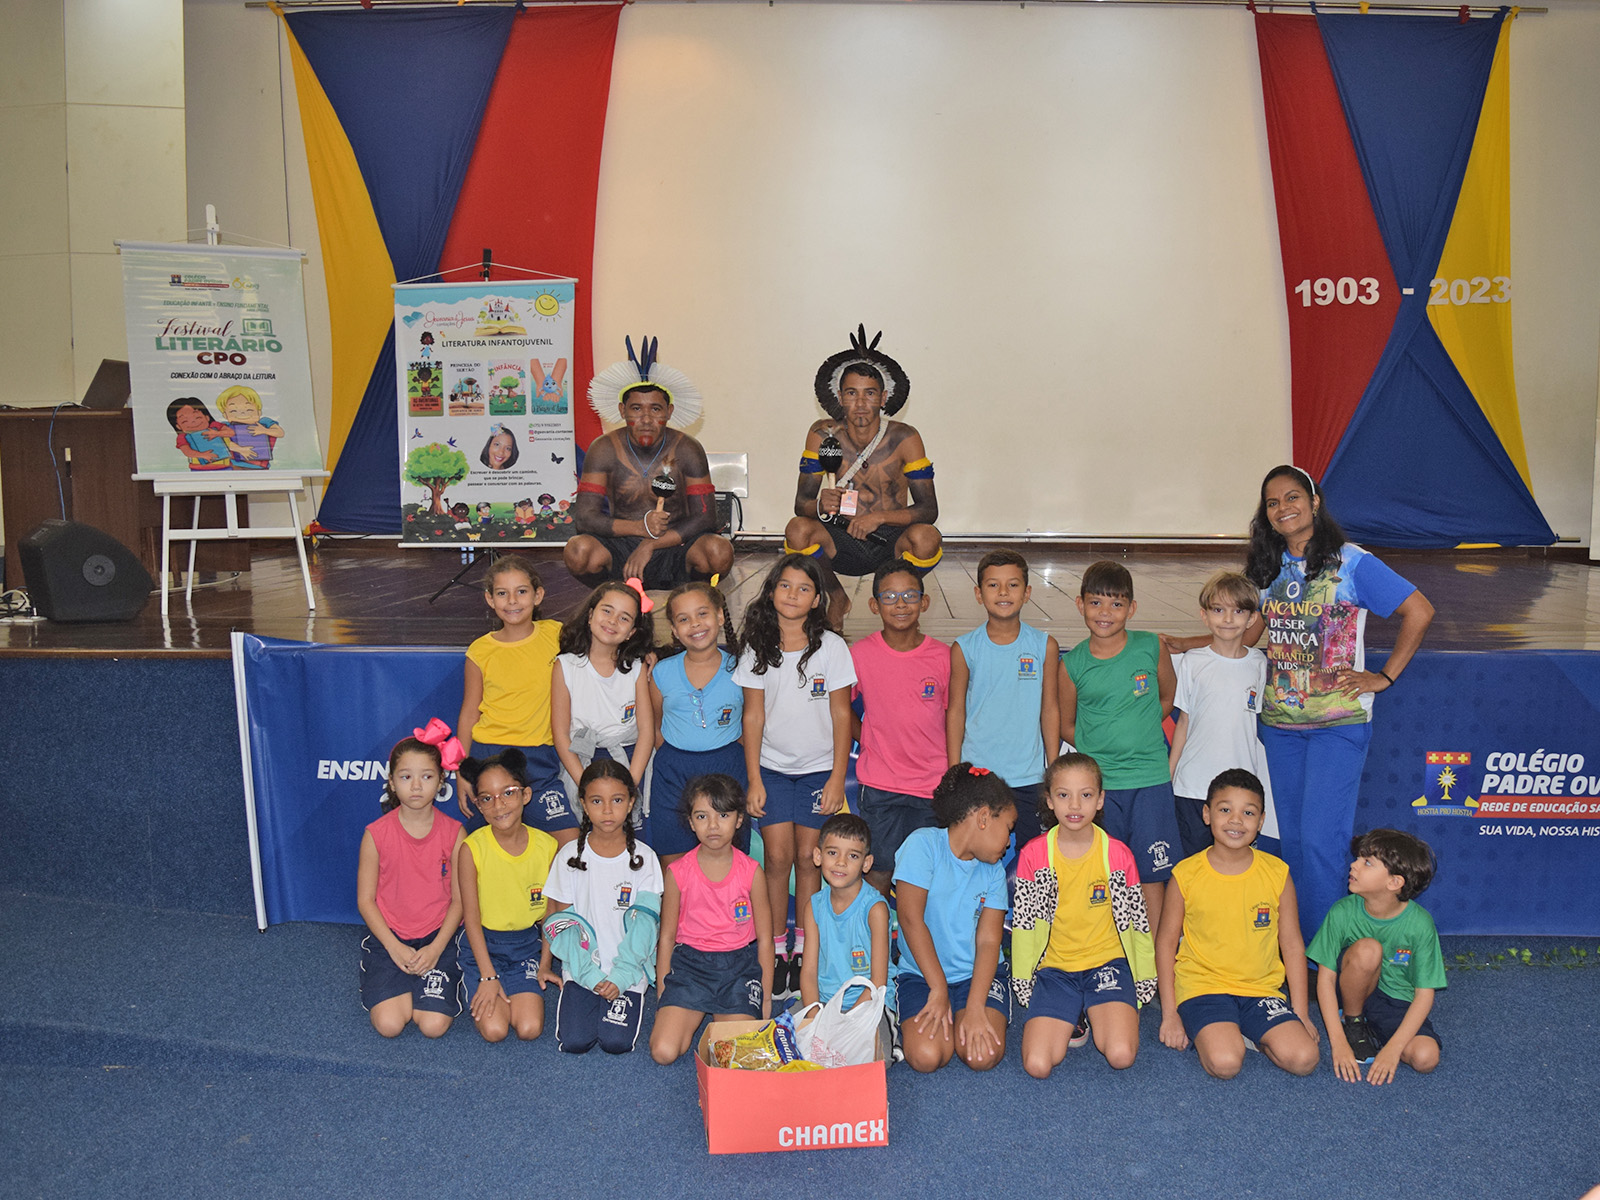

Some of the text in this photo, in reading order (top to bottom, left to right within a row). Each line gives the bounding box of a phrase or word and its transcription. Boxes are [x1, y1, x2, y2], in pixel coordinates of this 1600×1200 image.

[1295, 277, 1379, 307] 1903
[1430, 276, 1510, 305] 2023
[157, 318, 234, 337] Festival
[156, 335, 282, 352] LITERÁRIO
[488, 339, 552, 347] INFANTOJUVENIL
[197, 352, 246, 365] CPO
[494, 363, 521, 372] INFÂNCIA
[220, 372, 242, 380] ABRAÇO
[1286, 581, 1300, 599] O
[1262, 597, 1322, 616] ENCANTO
[1278, 661, 1298, 670] KIDS
[1486, 748, 1584, 773] COLÉGIO
[1481, 774, 1566, 794] PADRE
[1452, 808, 1472, 816] HOSTIA
[1480, 802, 1510, 812] REDE
[1512, 803, 1528, 812] DE
[1530, 802, 1587, 814] EDUCAÇÃO
[1479, 826, 1502, 835] SUA
[1506, 826, 1536, 837] VIDA,
[1539, 826, 1579, 836] NOSSA
[779, 1119, 884, 1147] CHAMEX
